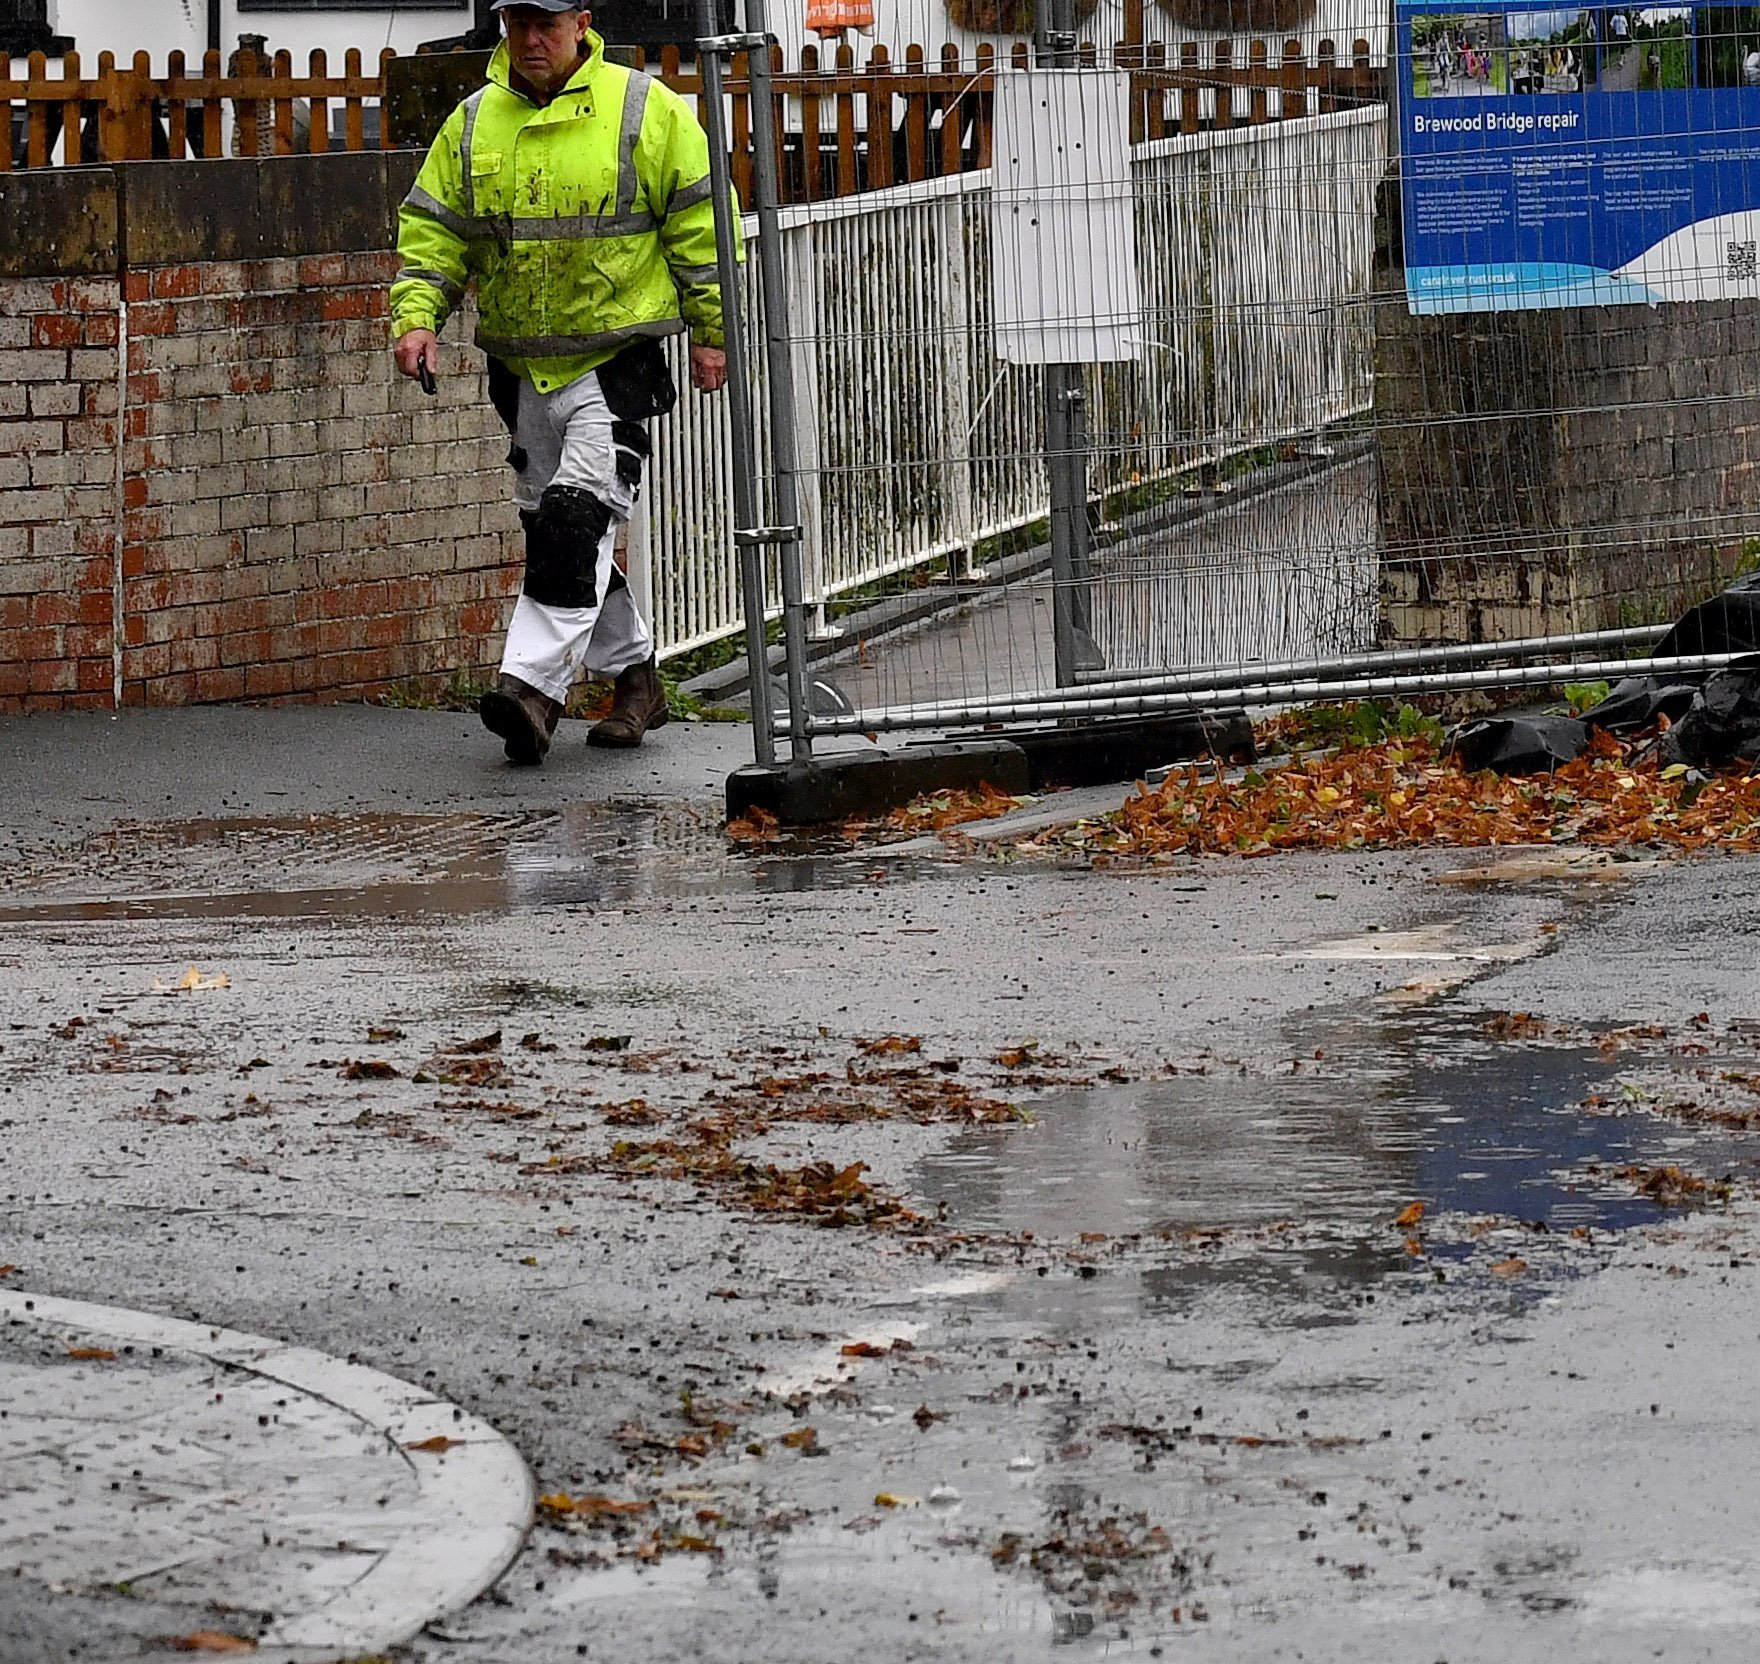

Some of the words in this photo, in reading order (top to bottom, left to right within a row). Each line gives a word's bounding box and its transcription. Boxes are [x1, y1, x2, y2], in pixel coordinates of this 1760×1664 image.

[1414, 113, 1482, 133] Brewood
[1486, 112, 1534, 134] Bridge
[1538, 110, 1580, 133] repair
